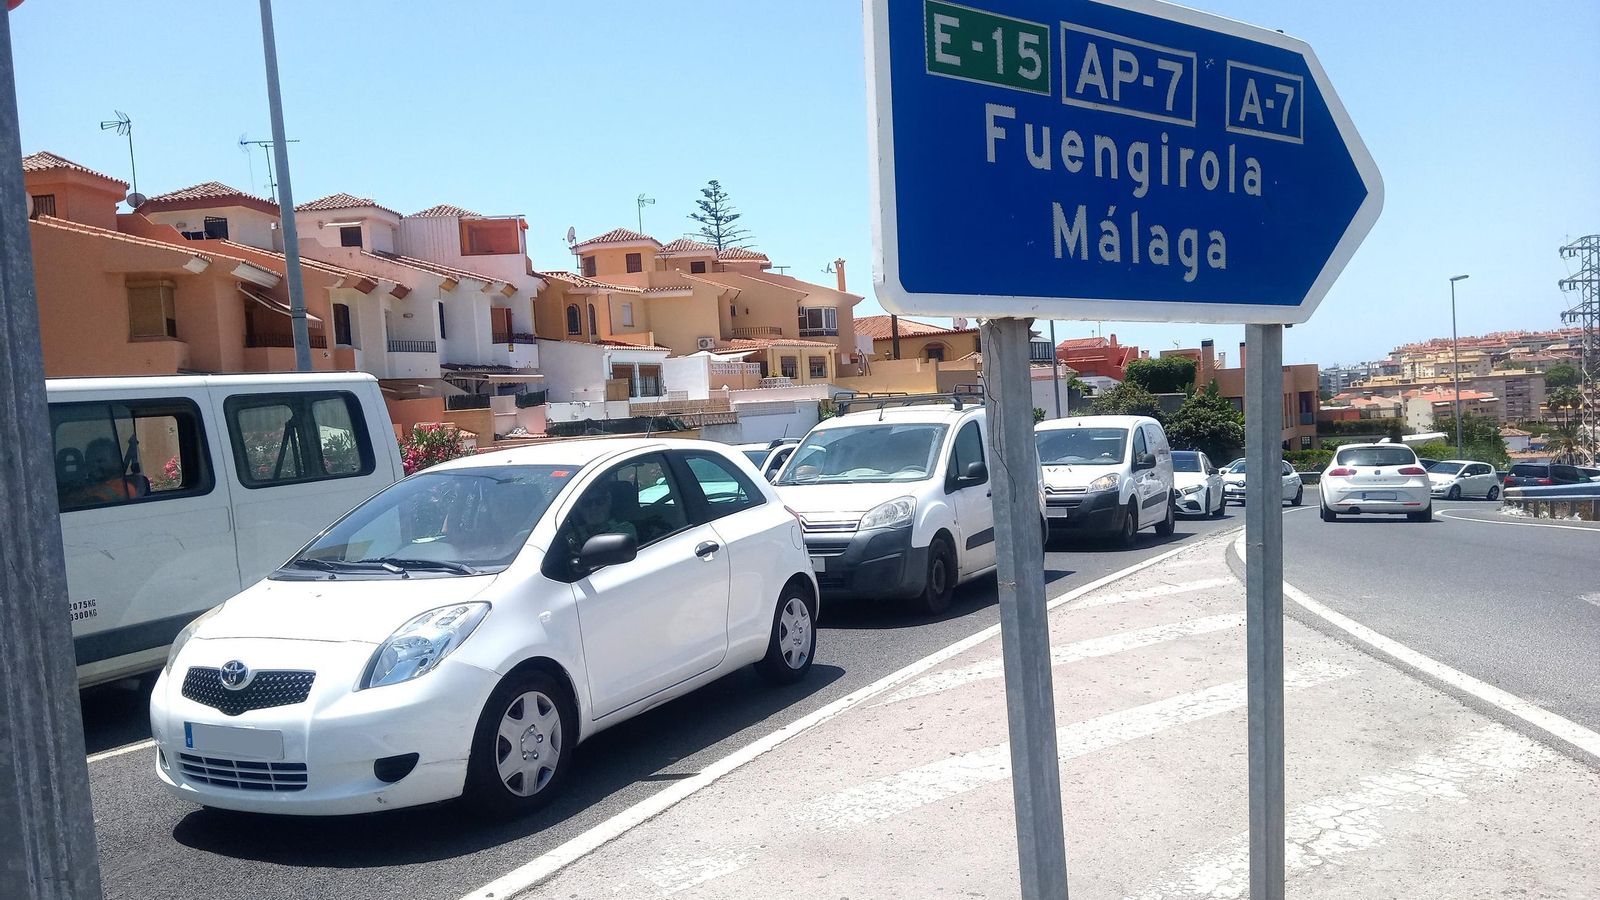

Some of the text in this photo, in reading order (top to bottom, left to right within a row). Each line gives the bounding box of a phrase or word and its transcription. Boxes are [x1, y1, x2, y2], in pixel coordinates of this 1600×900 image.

[933, 12, 1043, 81] E-15
[1074, 41, 1184, 112] AP-7
[1238, 77, 1296, 130] A-7
[984, 102, 1263, 198] Fuengirola
[1052, 201, 1228, 283] Málaga
